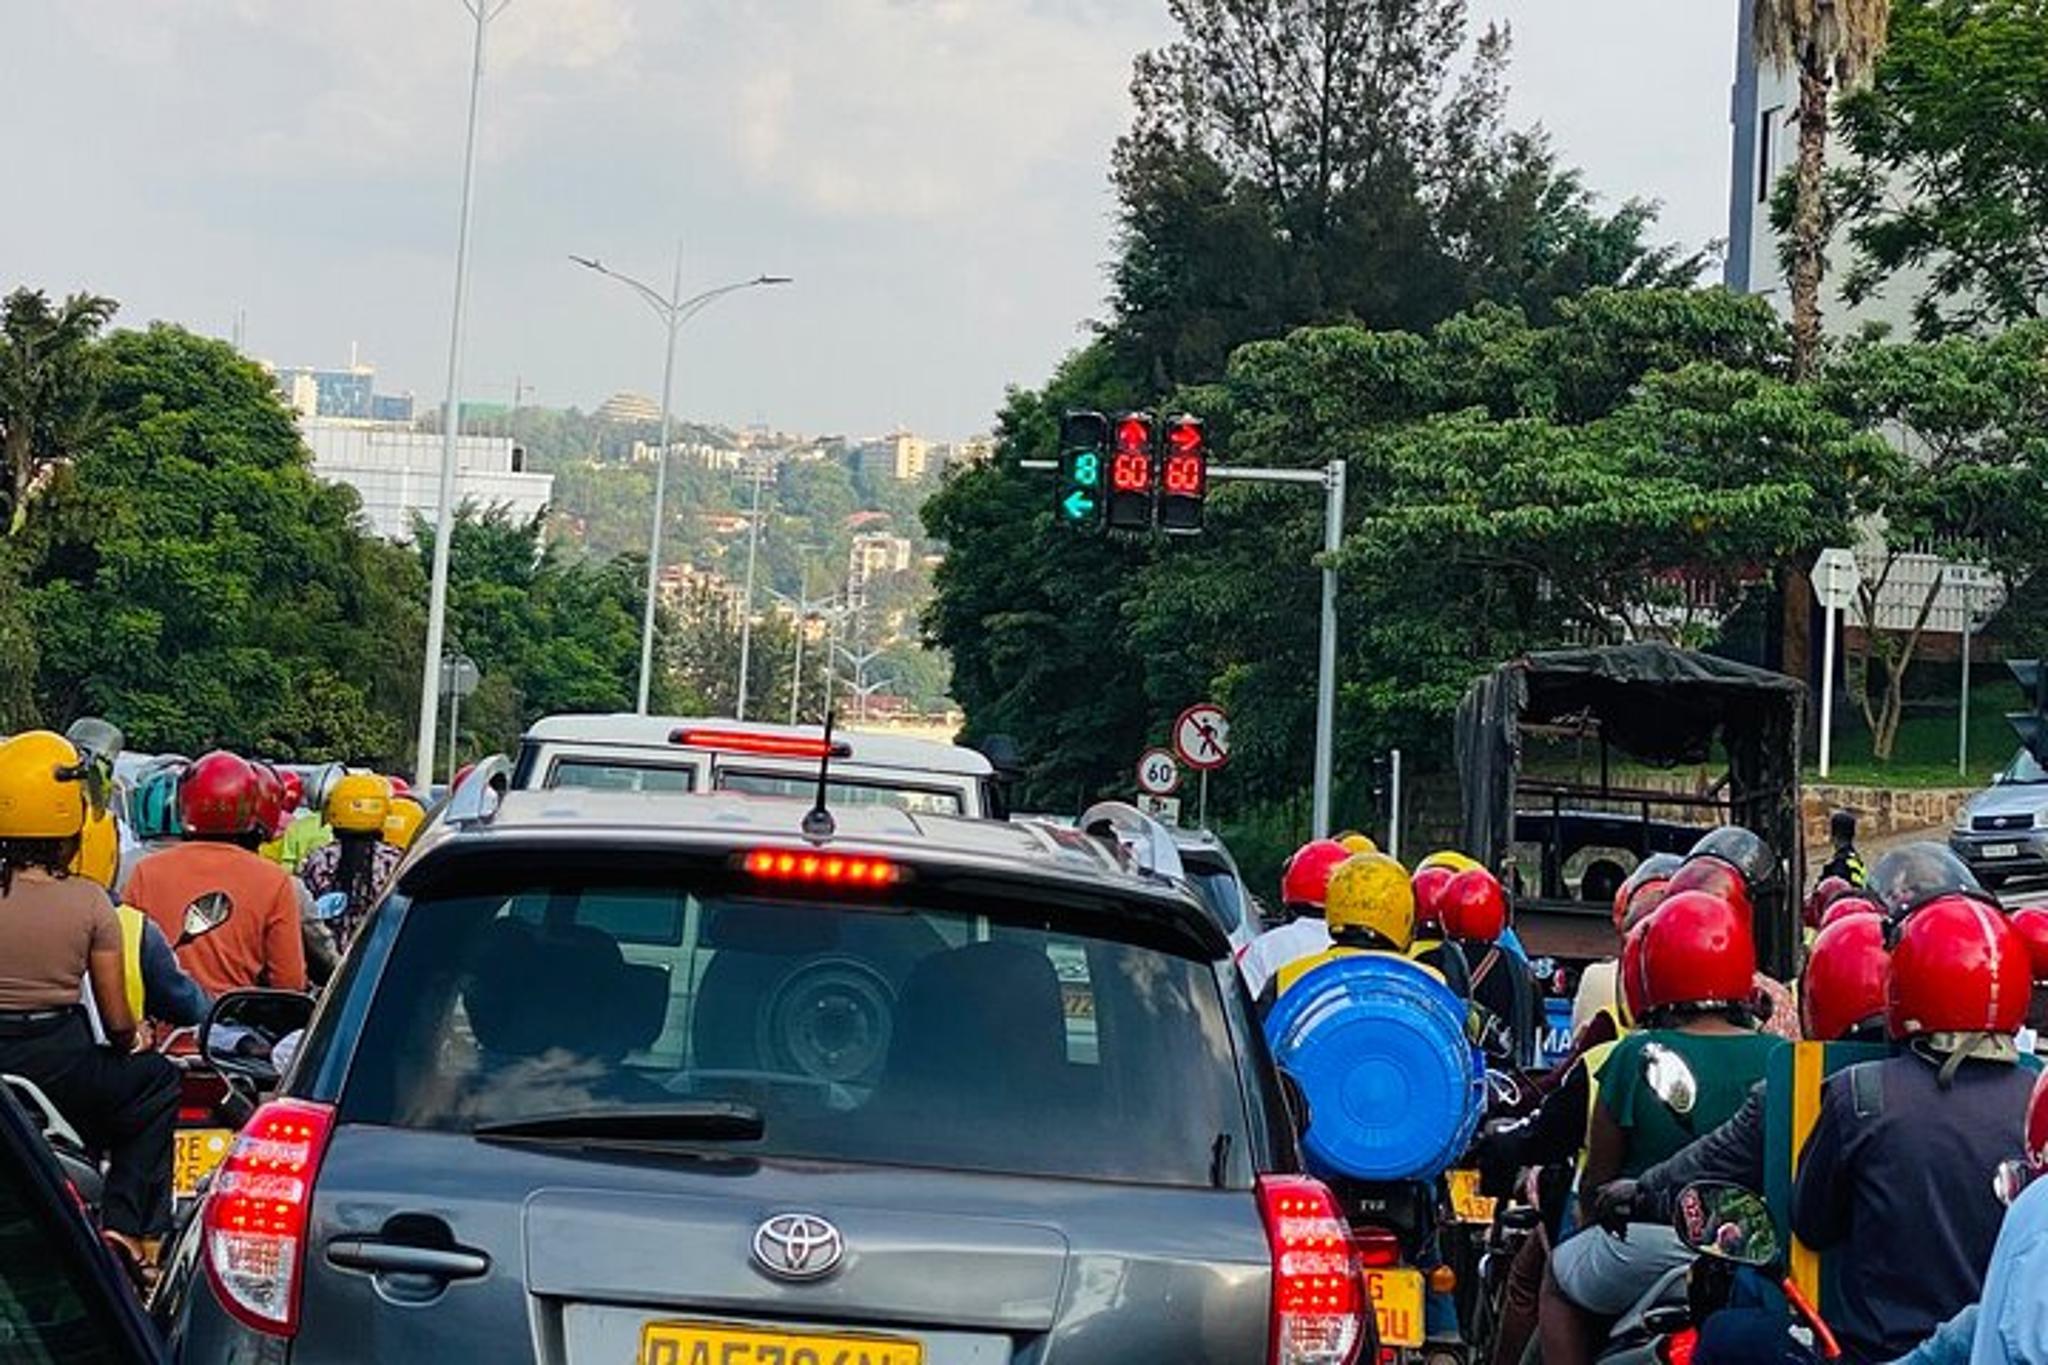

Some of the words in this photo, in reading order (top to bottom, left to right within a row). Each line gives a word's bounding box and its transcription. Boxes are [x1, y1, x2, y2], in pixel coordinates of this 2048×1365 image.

[1075, 453, 1097, 484] 8
[1114, 454, 1147, 487] 60
[1167, 458, 1199, 490] 60
[1148, 763, 1170, 782] 60
